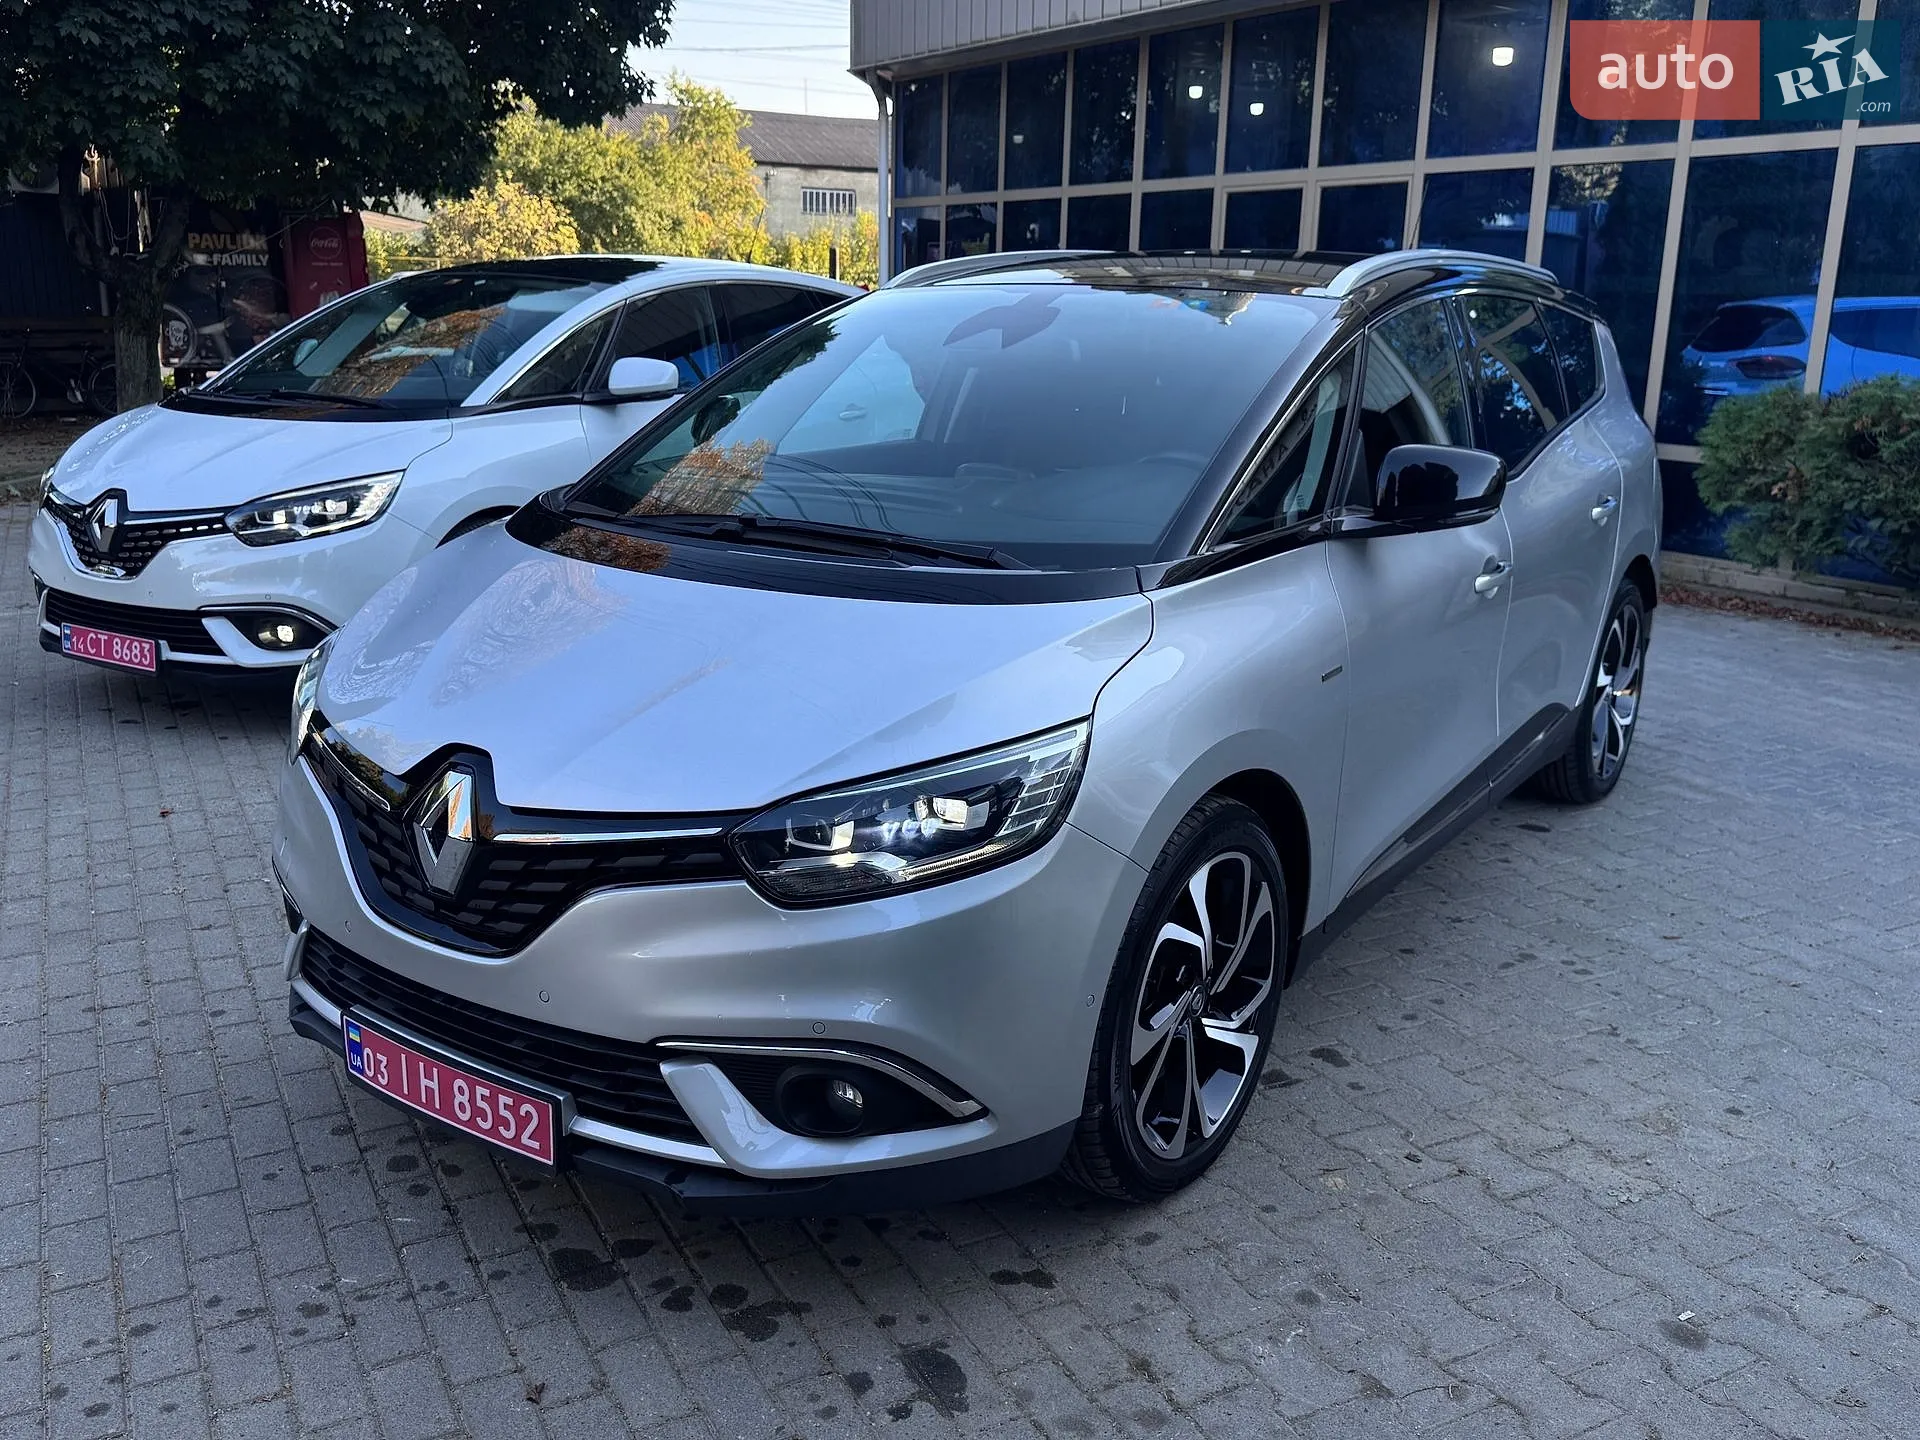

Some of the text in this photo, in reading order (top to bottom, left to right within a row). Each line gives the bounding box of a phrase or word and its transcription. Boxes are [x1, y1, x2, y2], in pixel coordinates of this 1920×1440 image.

[72, 632, 150, 665] 14 CT 8683
[350, 1053, 362, 1070] UA
[363, 1047, 389, 1086] 03
[453, 1078, 541, 1150] 8552
